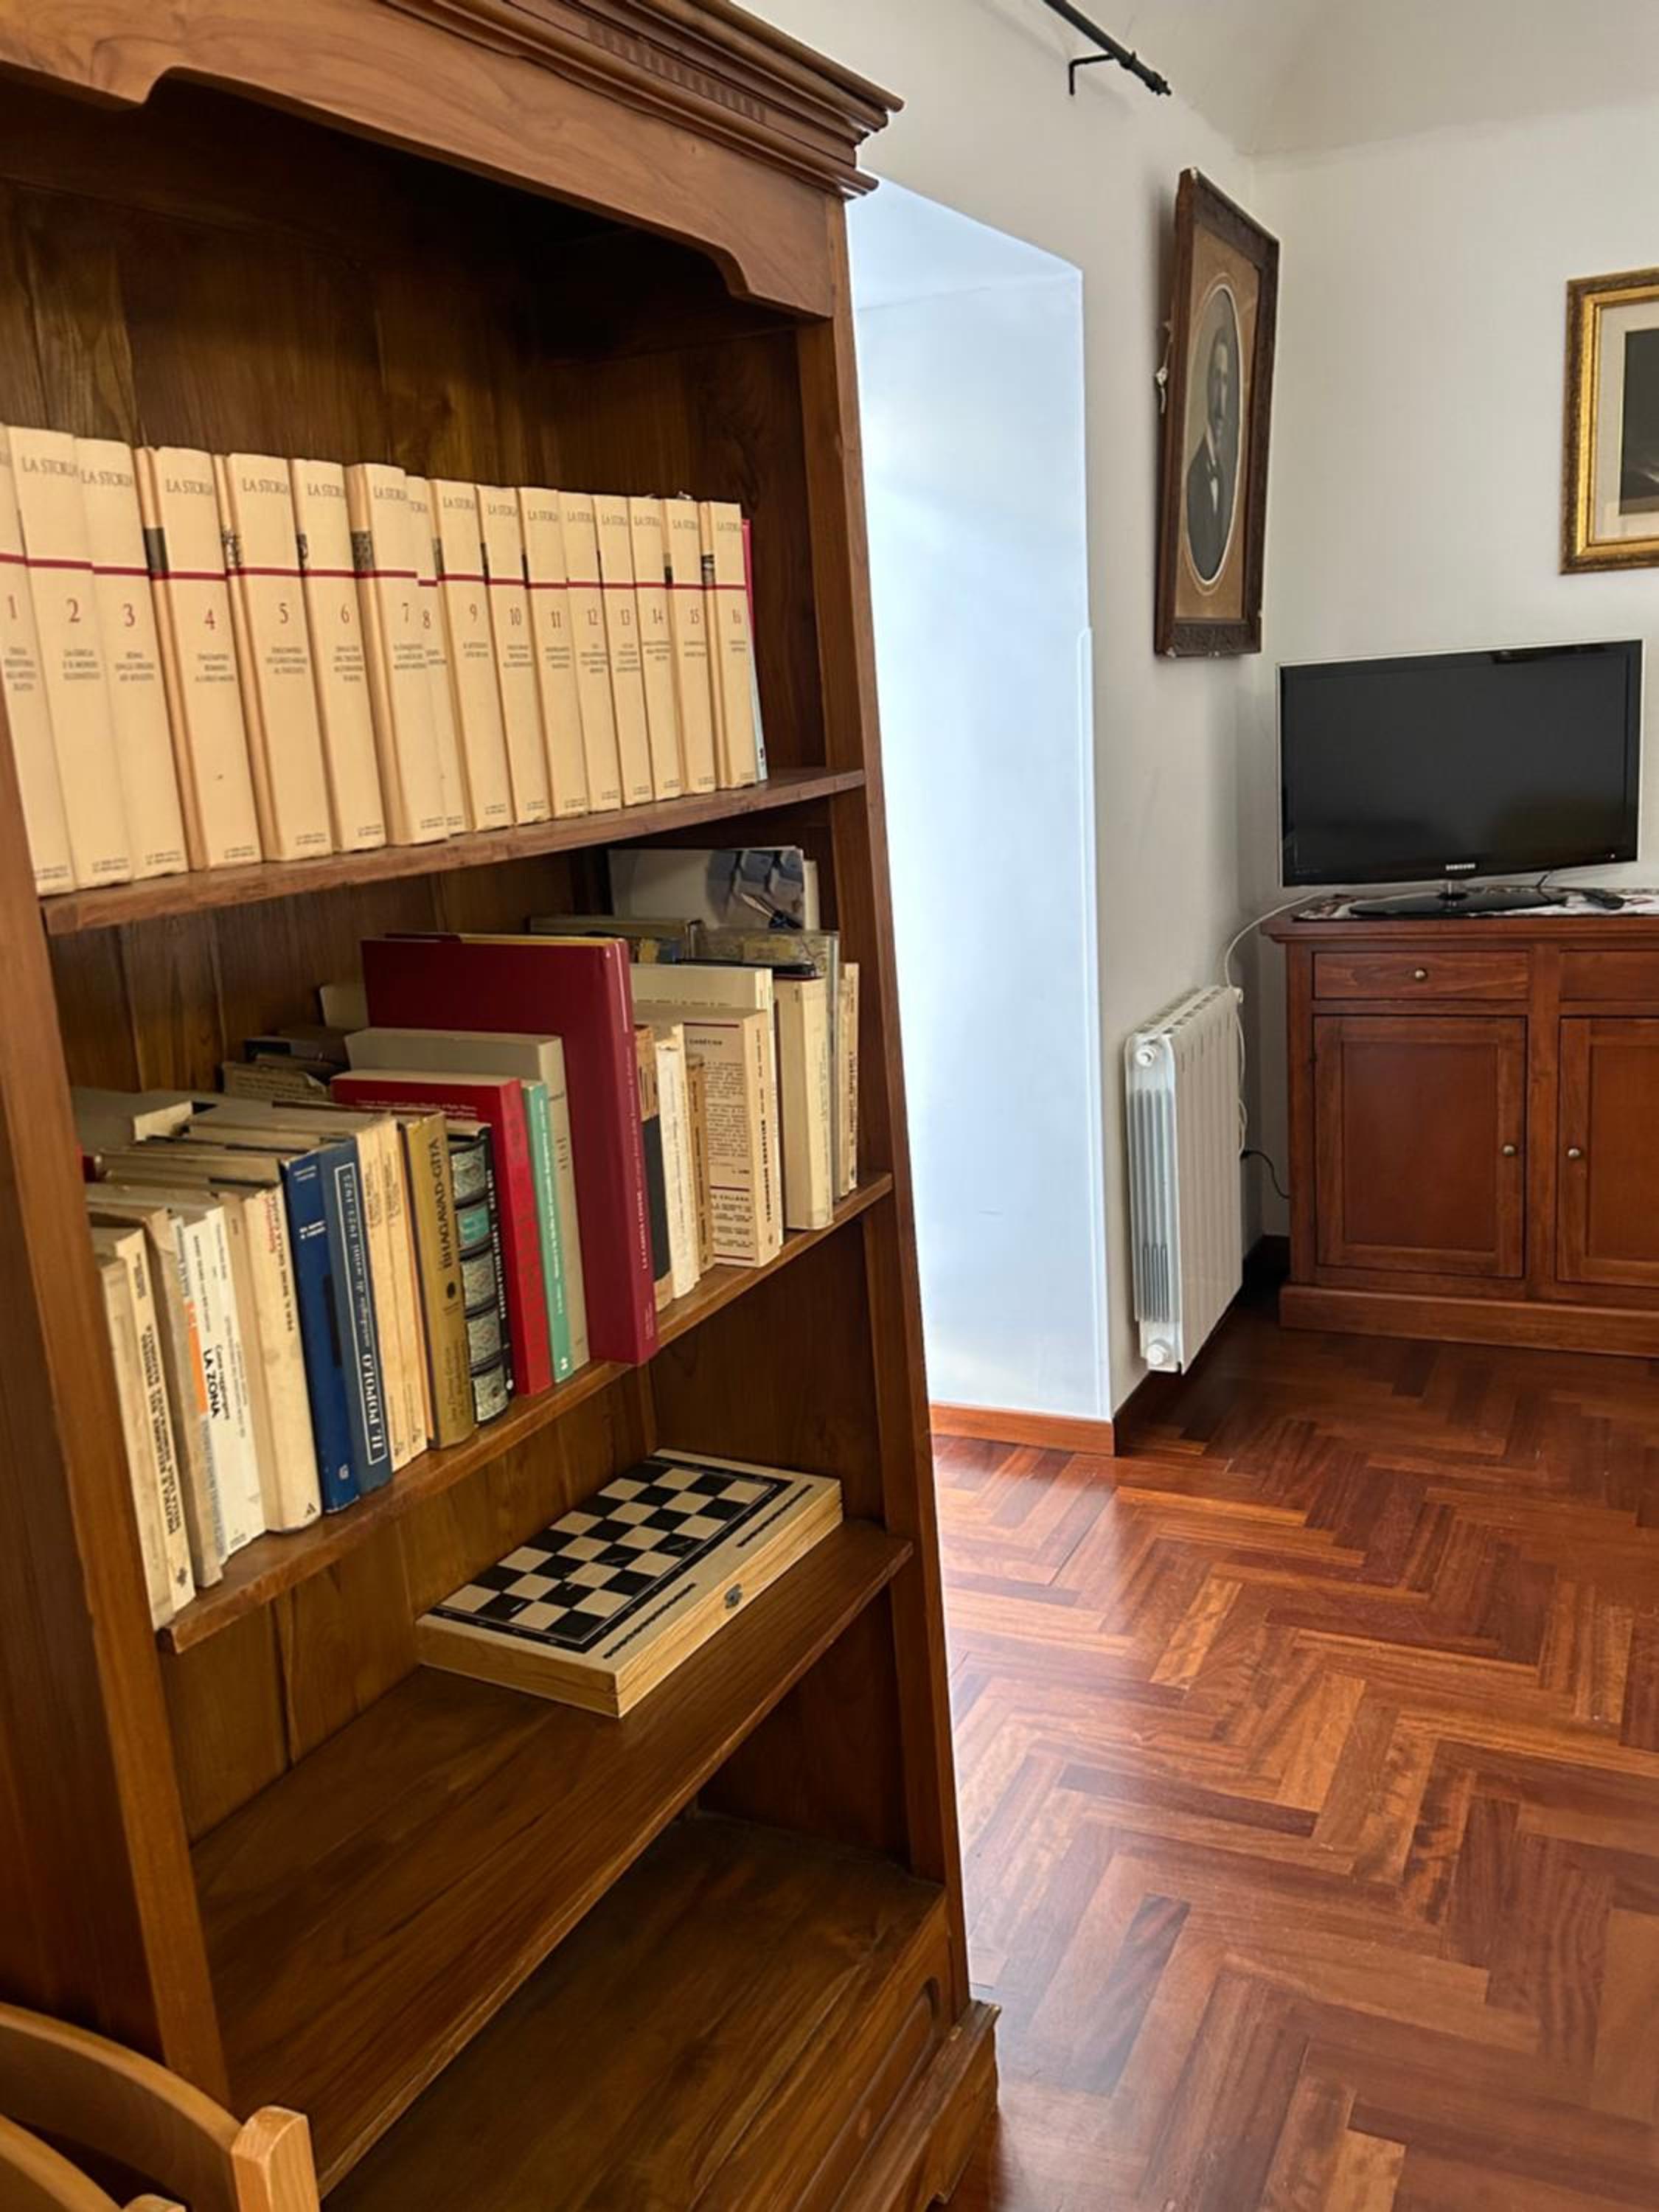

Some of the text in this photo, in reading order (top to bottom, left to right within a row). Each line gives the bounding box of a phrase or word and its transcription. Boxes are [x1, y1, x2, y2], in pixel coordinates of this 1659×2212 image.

[22, 456, 37, 472] LA
[81, 469, 94, 484] LA
[243, 478, 257, 493] LA
[166, 479, 182, 493] LA
[307, 482, 321, 496] LA
[8, 595, 17, 619] 1
[66, 598, 81, 622] 2
[122, 603, 135, 627] 3
[279, 602, 288, 624] 5
[341, 604, 350, 623] 6
[402, 602, 408, 622] 7
[470, 603, 477, 622] 9
[653, 608, 663, 624] 14
[204, 609, 216, 630] 4
[422, 611, 431, 629] 8
[509, 608, 521, 625] 10
[551, 611, 561, 628] 11
[588, 608, 597, 625] 12
[621, 609, 630, 626] 13
[690, 608, 700, 625] 15
[732, 609, 741, 624] 16
[202, 1348, 215, 1369] LA
[205, 1373, 223, 1418] ZONA
[362, 1353, 378, 1424] POPOLO
[370, 1428, 383, 1450] IL
